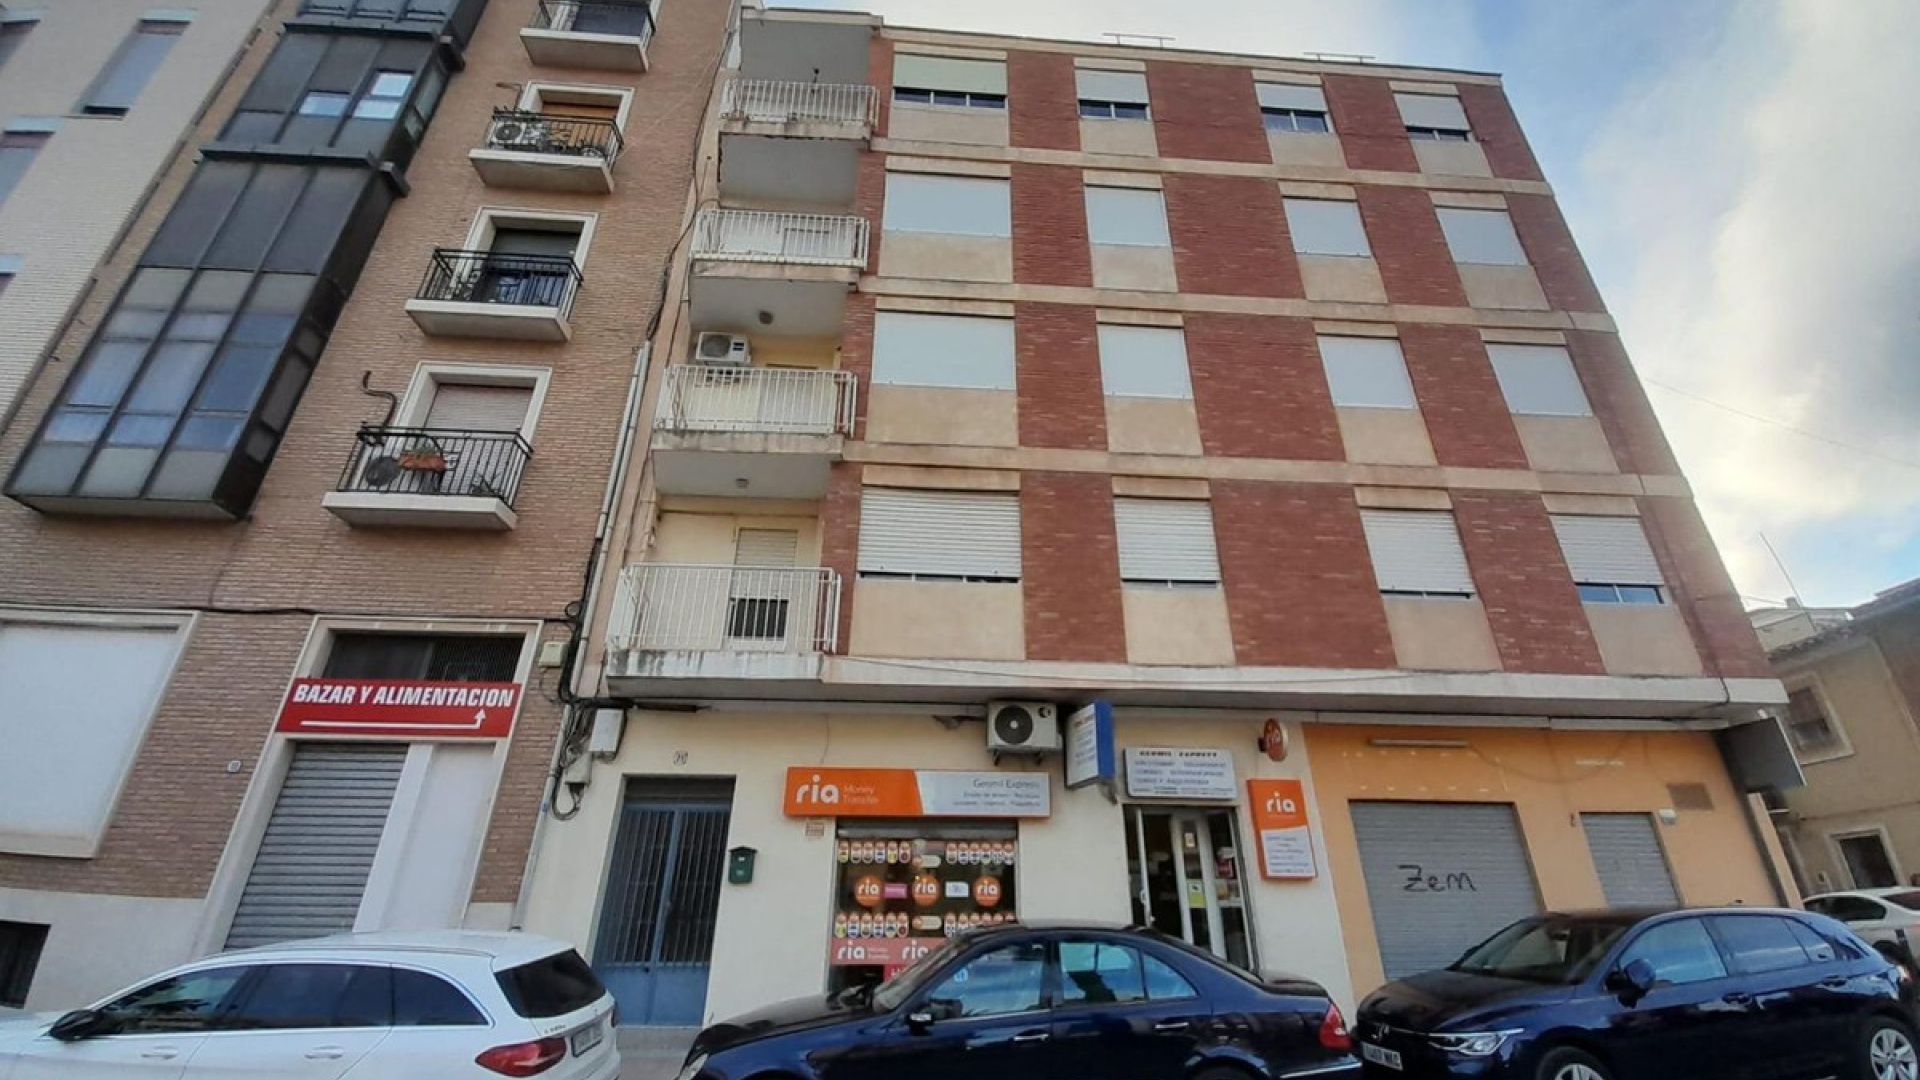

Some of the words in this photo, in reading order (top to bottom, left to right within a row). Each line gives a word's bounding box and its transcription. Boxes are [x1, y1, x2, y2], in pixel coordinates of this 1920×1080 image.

[293, 684, 356, 704] BAZAR
[360, 686, 373, 704] Y
[372, 687, 515, 707] ALIMENTACION
[796, 774, 840, 805] ria
[1266, 791, 1296, 813] ria
[858, 877, 879, 894] ria
[914, 877, 936, 894] ria
[977, 879, 998, 895] ria
[1397, 864, 1477, 892] Zem
[838, 940, 866, 960] ria
